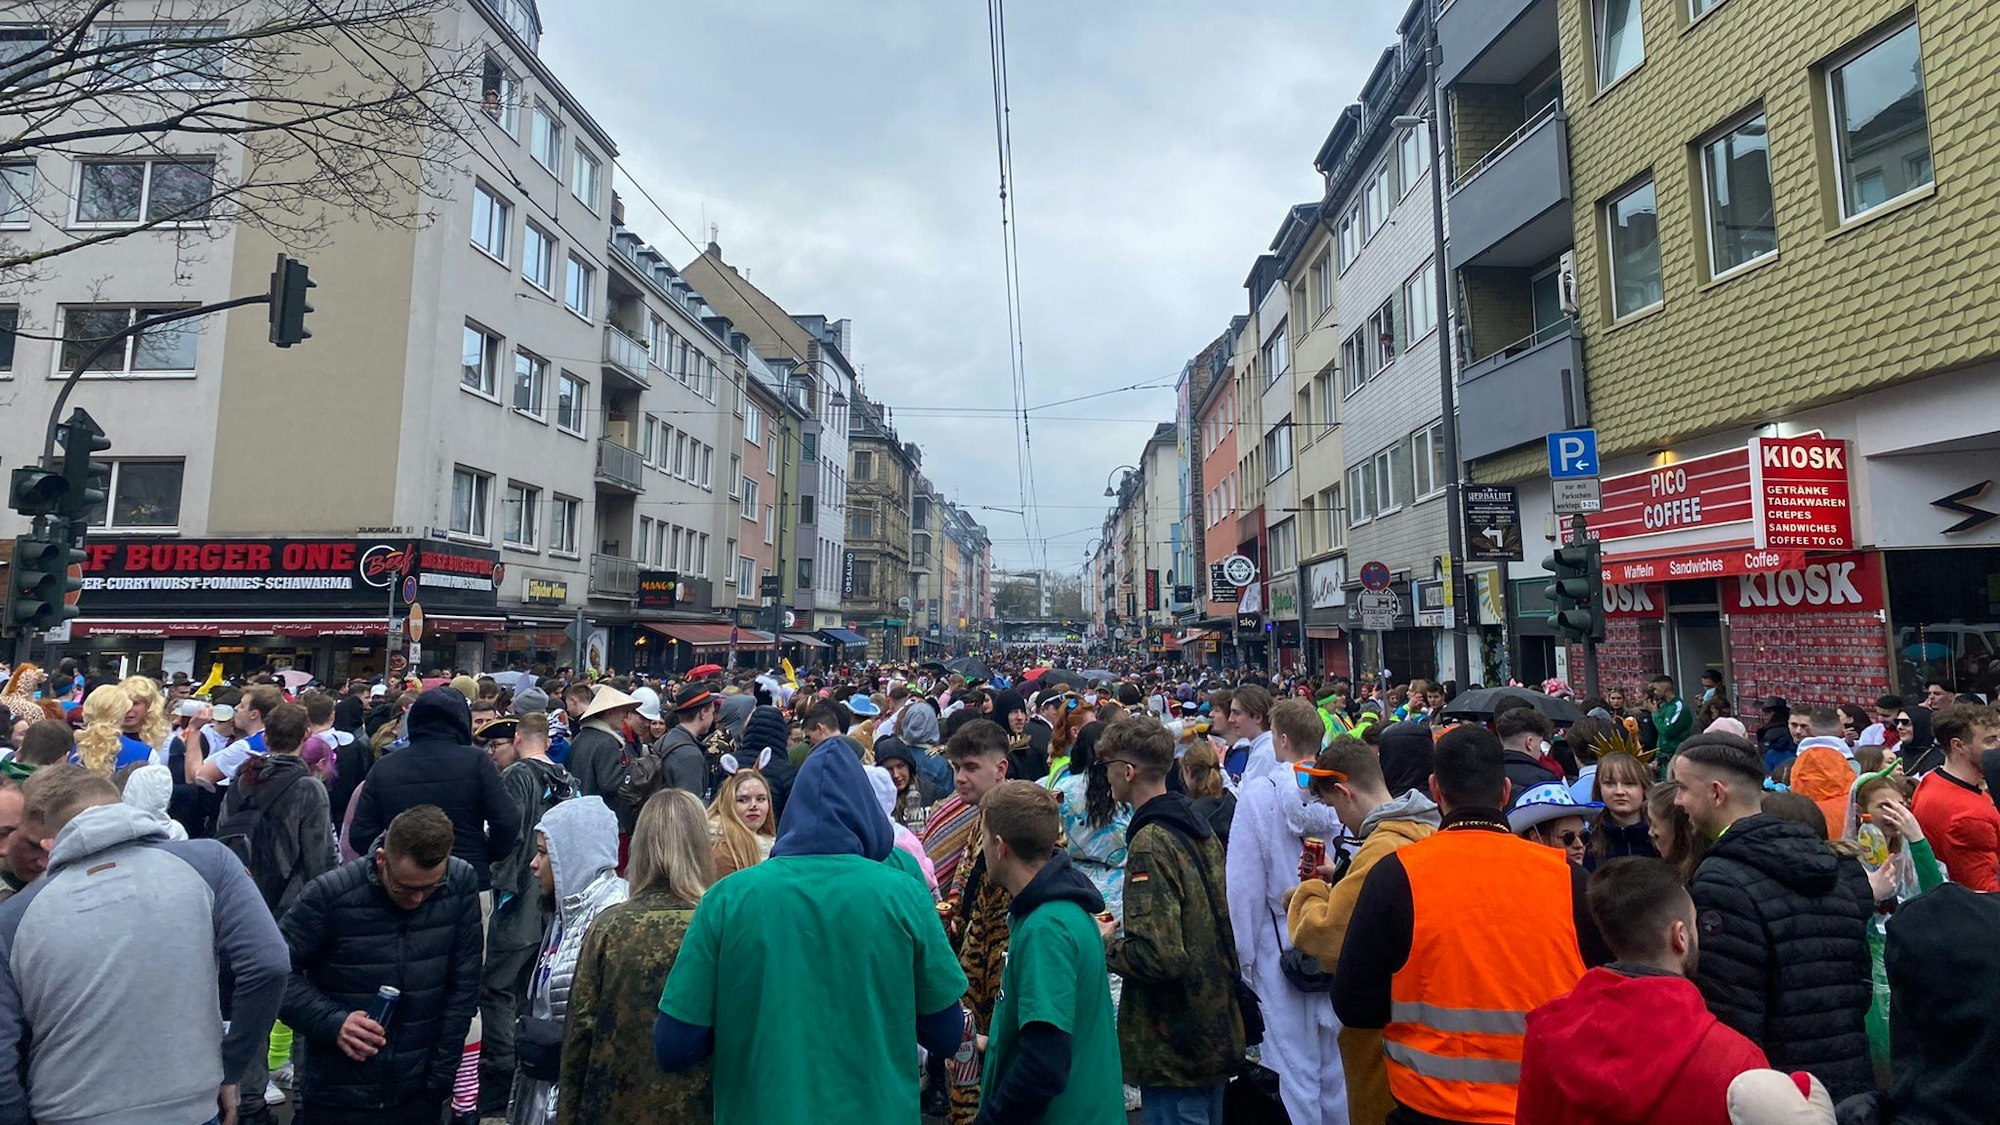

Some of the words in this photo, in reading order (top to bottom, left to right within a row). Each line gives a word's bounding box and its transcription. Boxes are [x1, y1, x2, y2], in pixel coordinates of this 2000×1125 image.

[1559, 437, 1585, 472] P
[1763, 445, 1844, 470] KIOSK
[1651, 468, 1687, 498] PICO
[1767, 484, 1829, 496] GETRÄNKE
[1468, 492, 1513, 502] HERBALIST
[1561, 492, 1592, 500] Parkschein
[1767, 497, 1846, 508] TABAKWAREN
[1644, 497, 1702, 529] COFFEE
[1769, 523, 1837, 534] SANDWICHES
[1770, 536, 1809, 545] COFFEE
[1812, 537, 1826, 546] TO
[1828, 537, 1844, 546] GO
[124, 543, 272, 571] BURGER
[282, 543, 356, 571] ONE
[1623, 564, 1654, 580] Waffeln
[1669, 557, 1723, 575] Sandwiches
[1744, 551, 1780, 570] Coffee
[1739, 561, 1863, 608] KIOSK
[1602, 583, 1654, 613] OSK
[1239, 617, 1257, 629] sky
